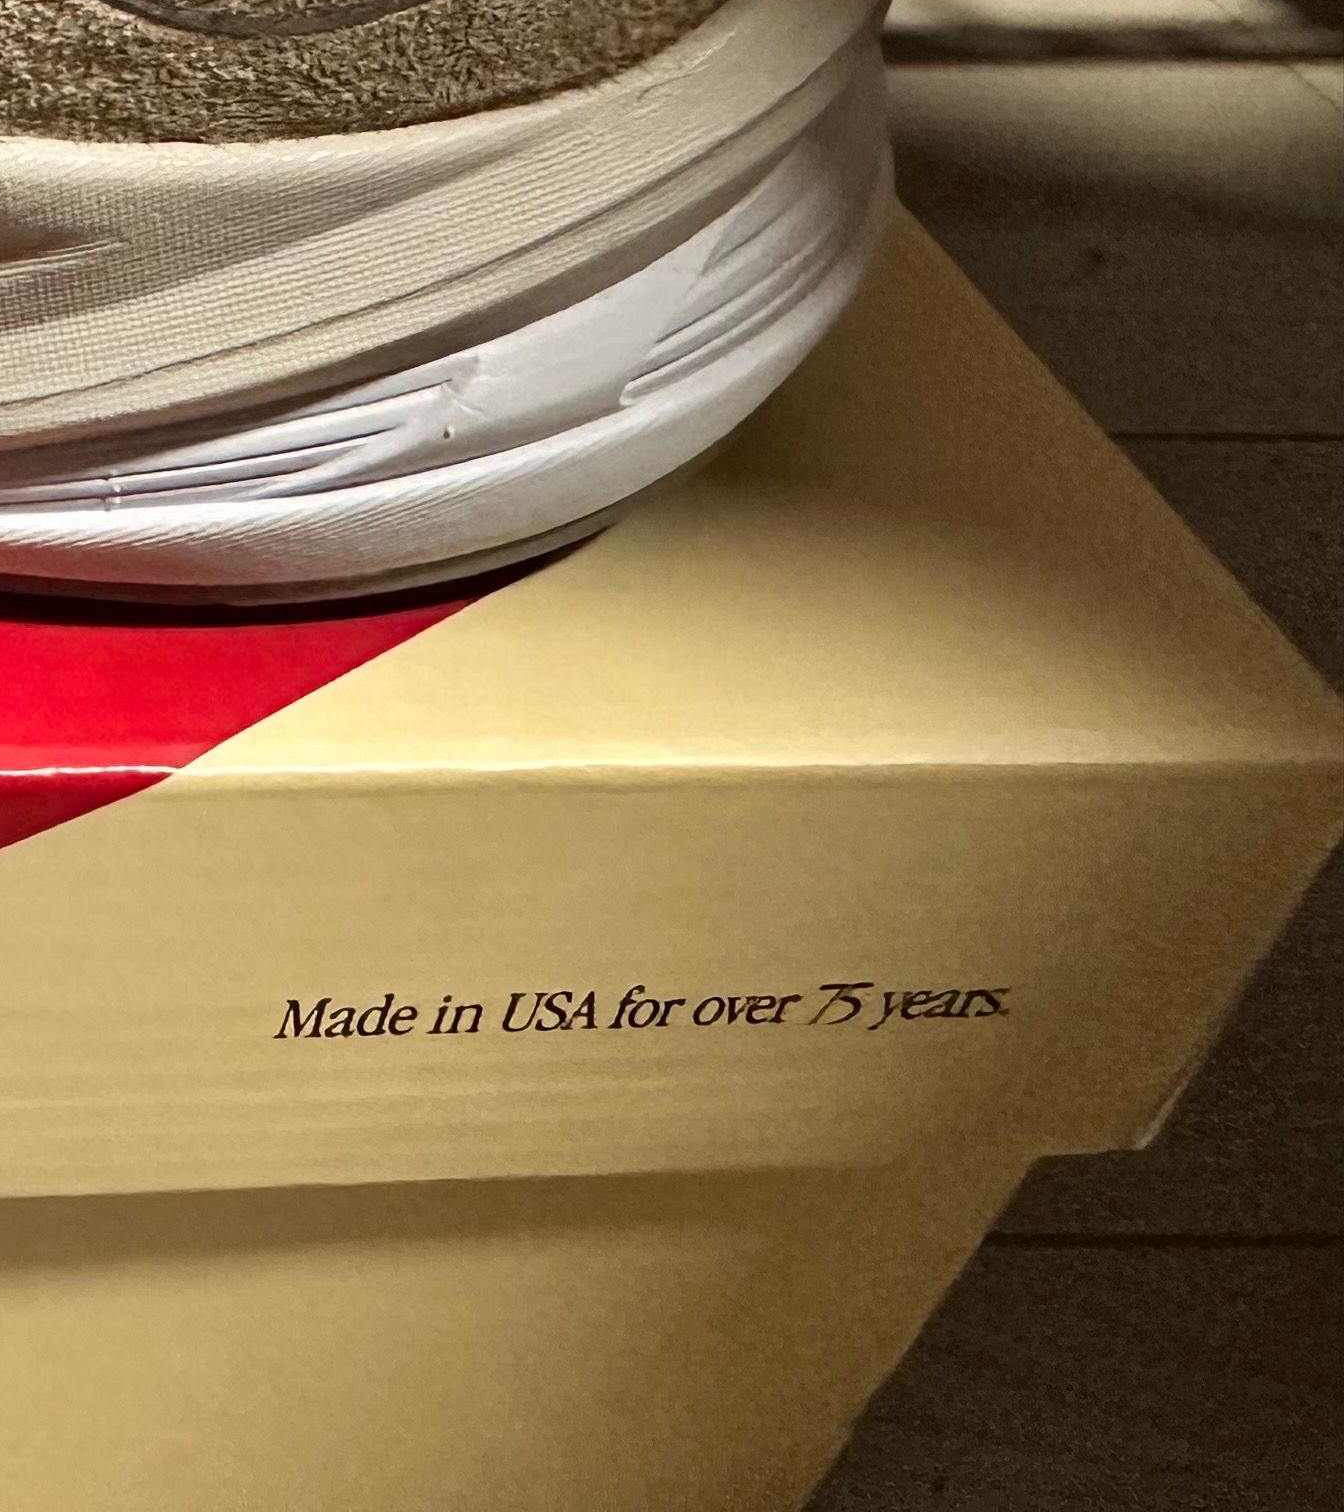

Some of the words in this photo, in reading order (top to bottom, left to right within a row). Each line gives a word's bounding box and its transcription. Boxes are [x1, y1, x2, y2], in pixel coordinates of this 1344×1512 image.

[272, 992, 418, 1040] Made
[426, 994, 484, 1034] in
[502, 990, 598, 1032] USA
[608, 984, 686, 1030] for
[693, 993, 803, 1026] over
[808, 982, 874, 1025] 75
